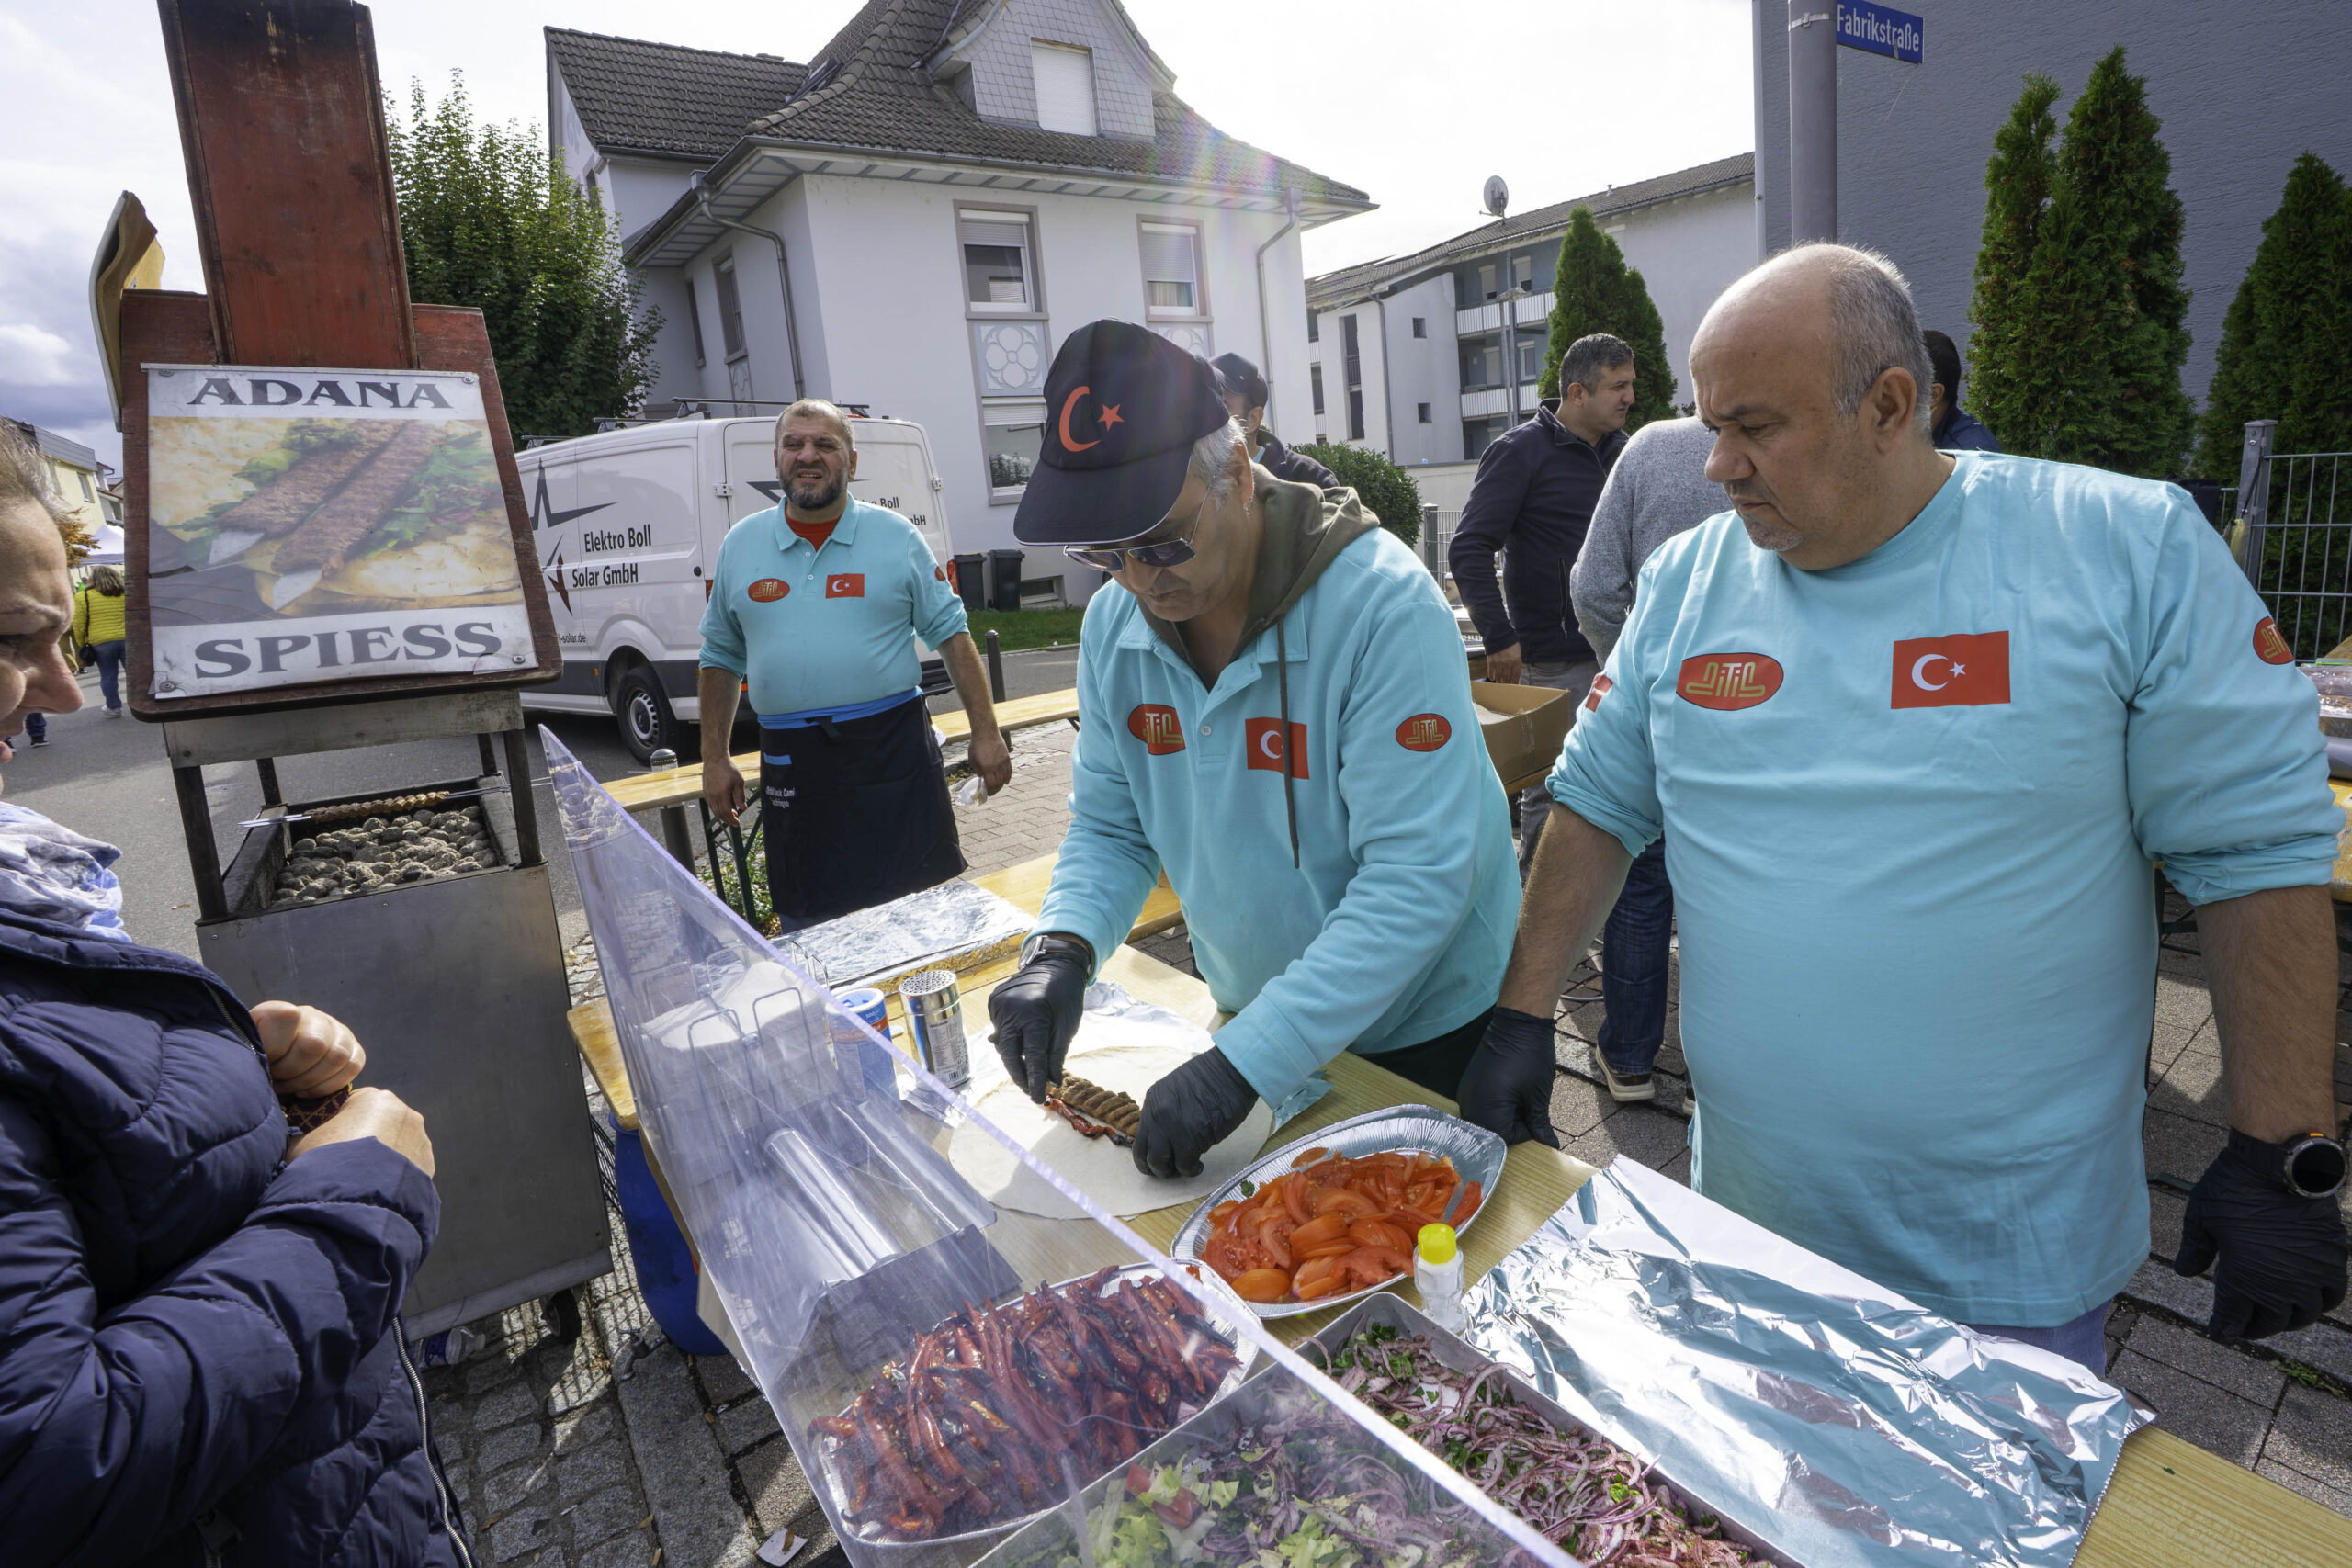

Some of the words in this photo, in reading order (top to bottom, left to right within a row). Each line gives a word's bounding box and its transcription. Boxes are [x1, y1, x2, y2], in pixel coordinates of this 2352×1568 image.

[1837, 4, 1920, 52] Fabrikstraße
[187, 378, 455, 409] ADANA
[879, 497, 899, 509] Boll
[584, 530, 625, 553] Elektro
[628, 524, 652, 548] Boll
[572, 566, 600, 589] Solar
[603, 562, 639, 586] GmbH
[194, 622, 503, 679] SPIESS
